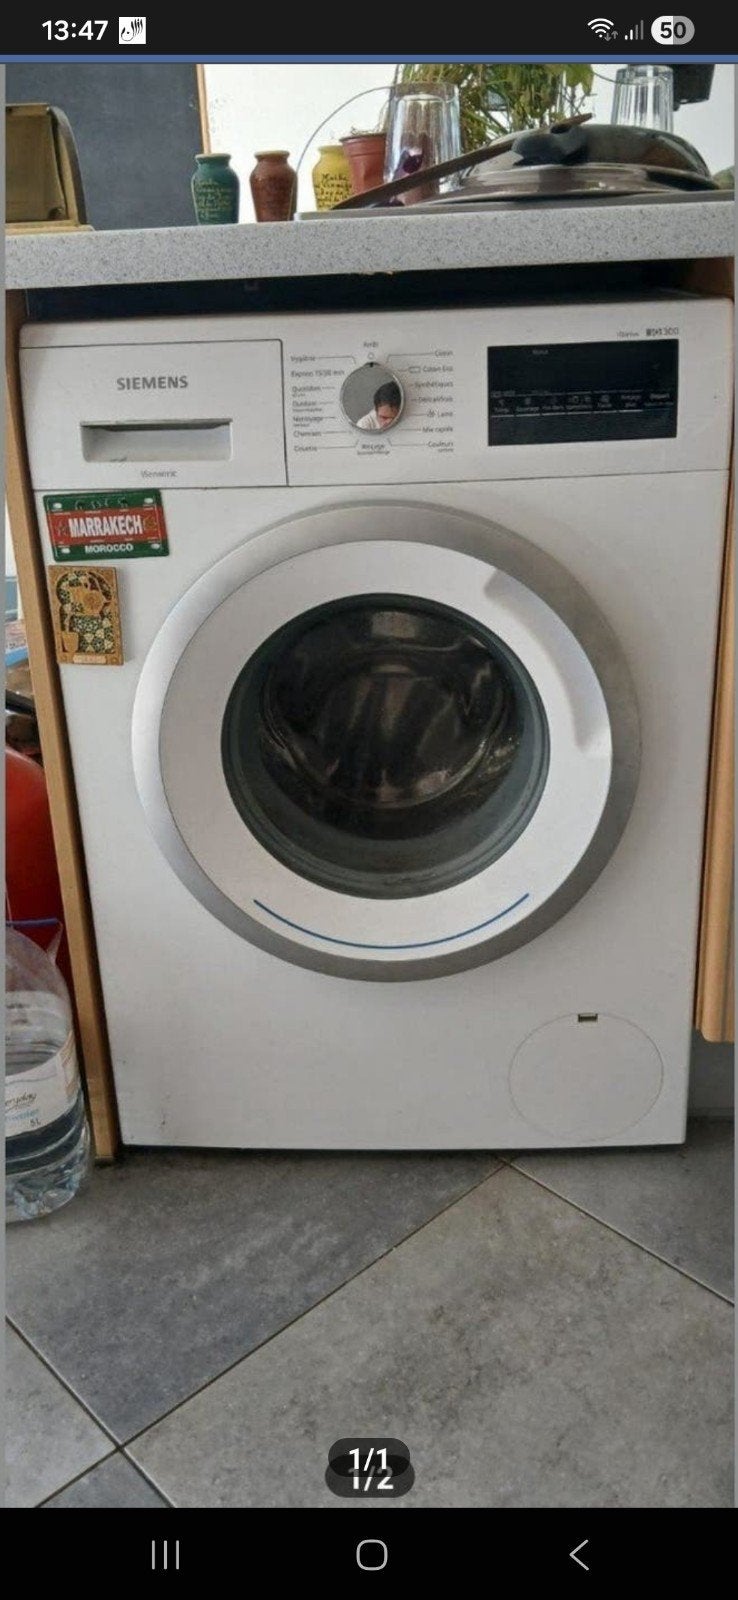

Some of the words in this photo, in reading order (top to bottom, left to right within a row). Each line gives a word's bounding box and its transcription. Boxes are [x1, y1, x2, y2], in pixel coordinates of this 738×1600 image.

[116, 375, 189, 391] SIEMENS
[68, 514, 144, 538] MARRAKECH
[84, 543, 134, 554] MOROCCO
